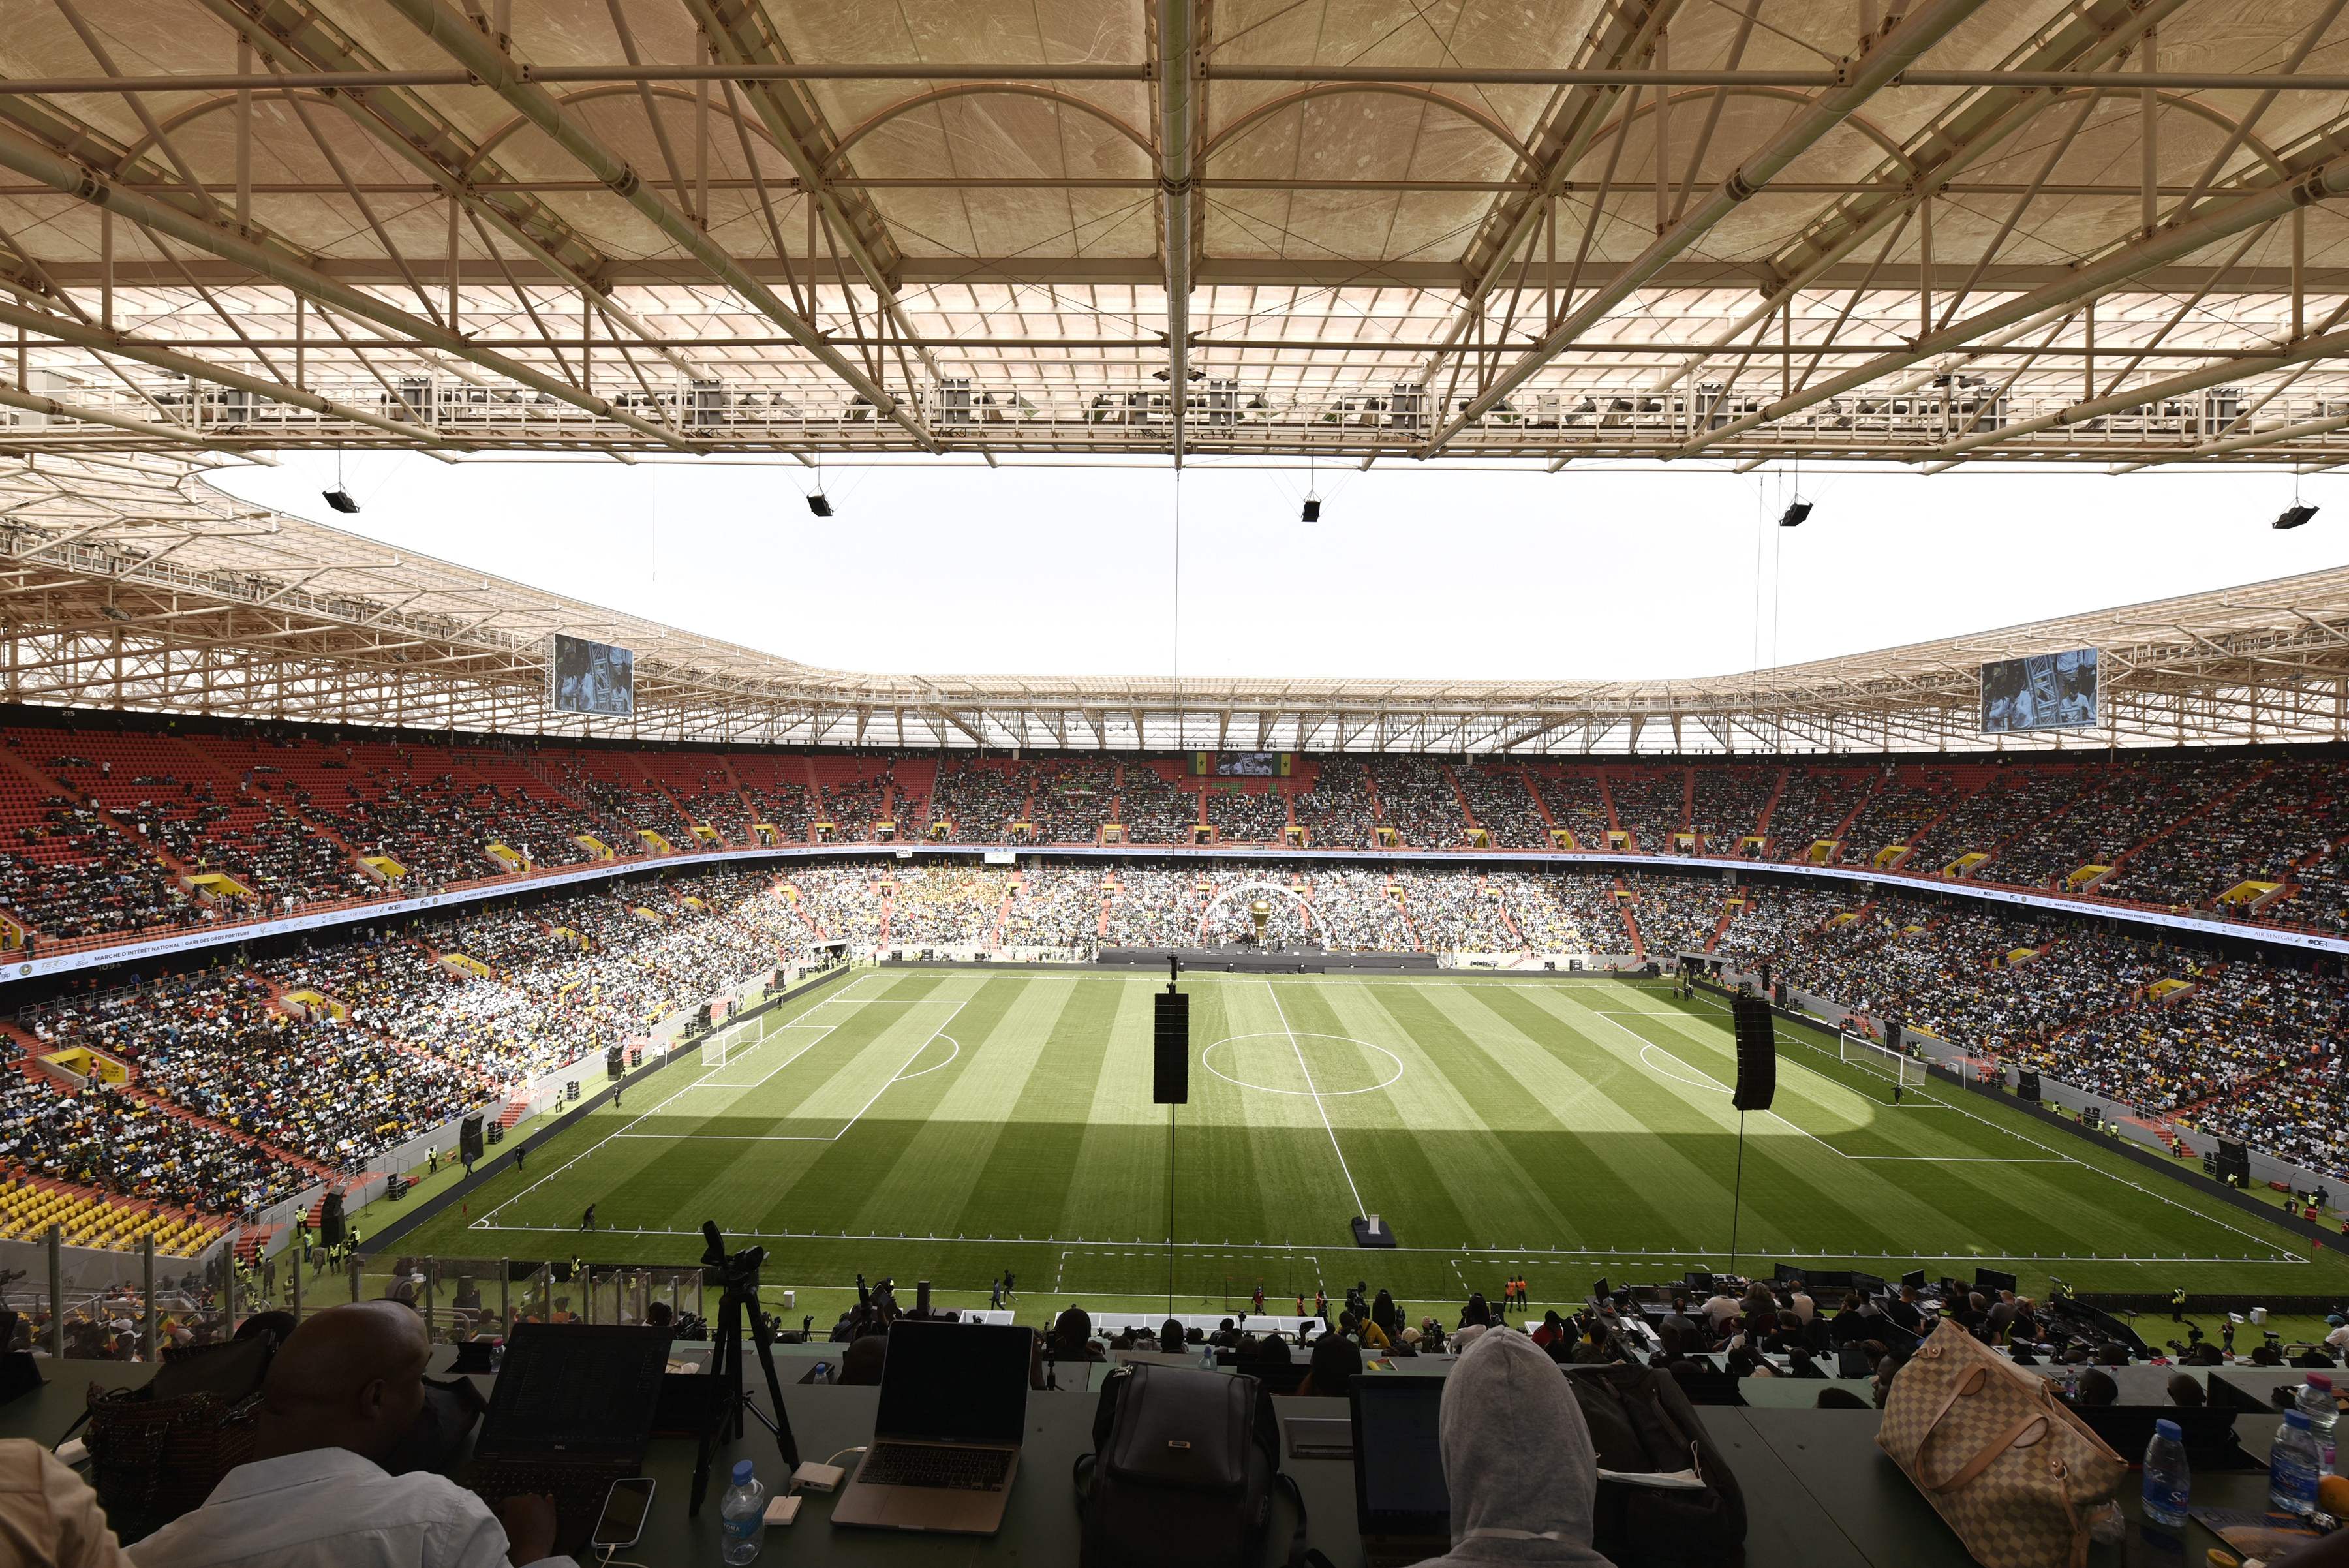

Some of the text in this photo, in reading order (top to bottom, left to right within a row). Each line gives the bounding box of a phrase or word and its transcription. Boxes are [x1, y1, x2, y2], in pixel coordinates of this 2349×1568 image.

[94, 953, 121, 961] MARCHE
[121, 947, 151, 957] D'INTÉRÊT
[151, 943, 179, 952] NATIONAL
